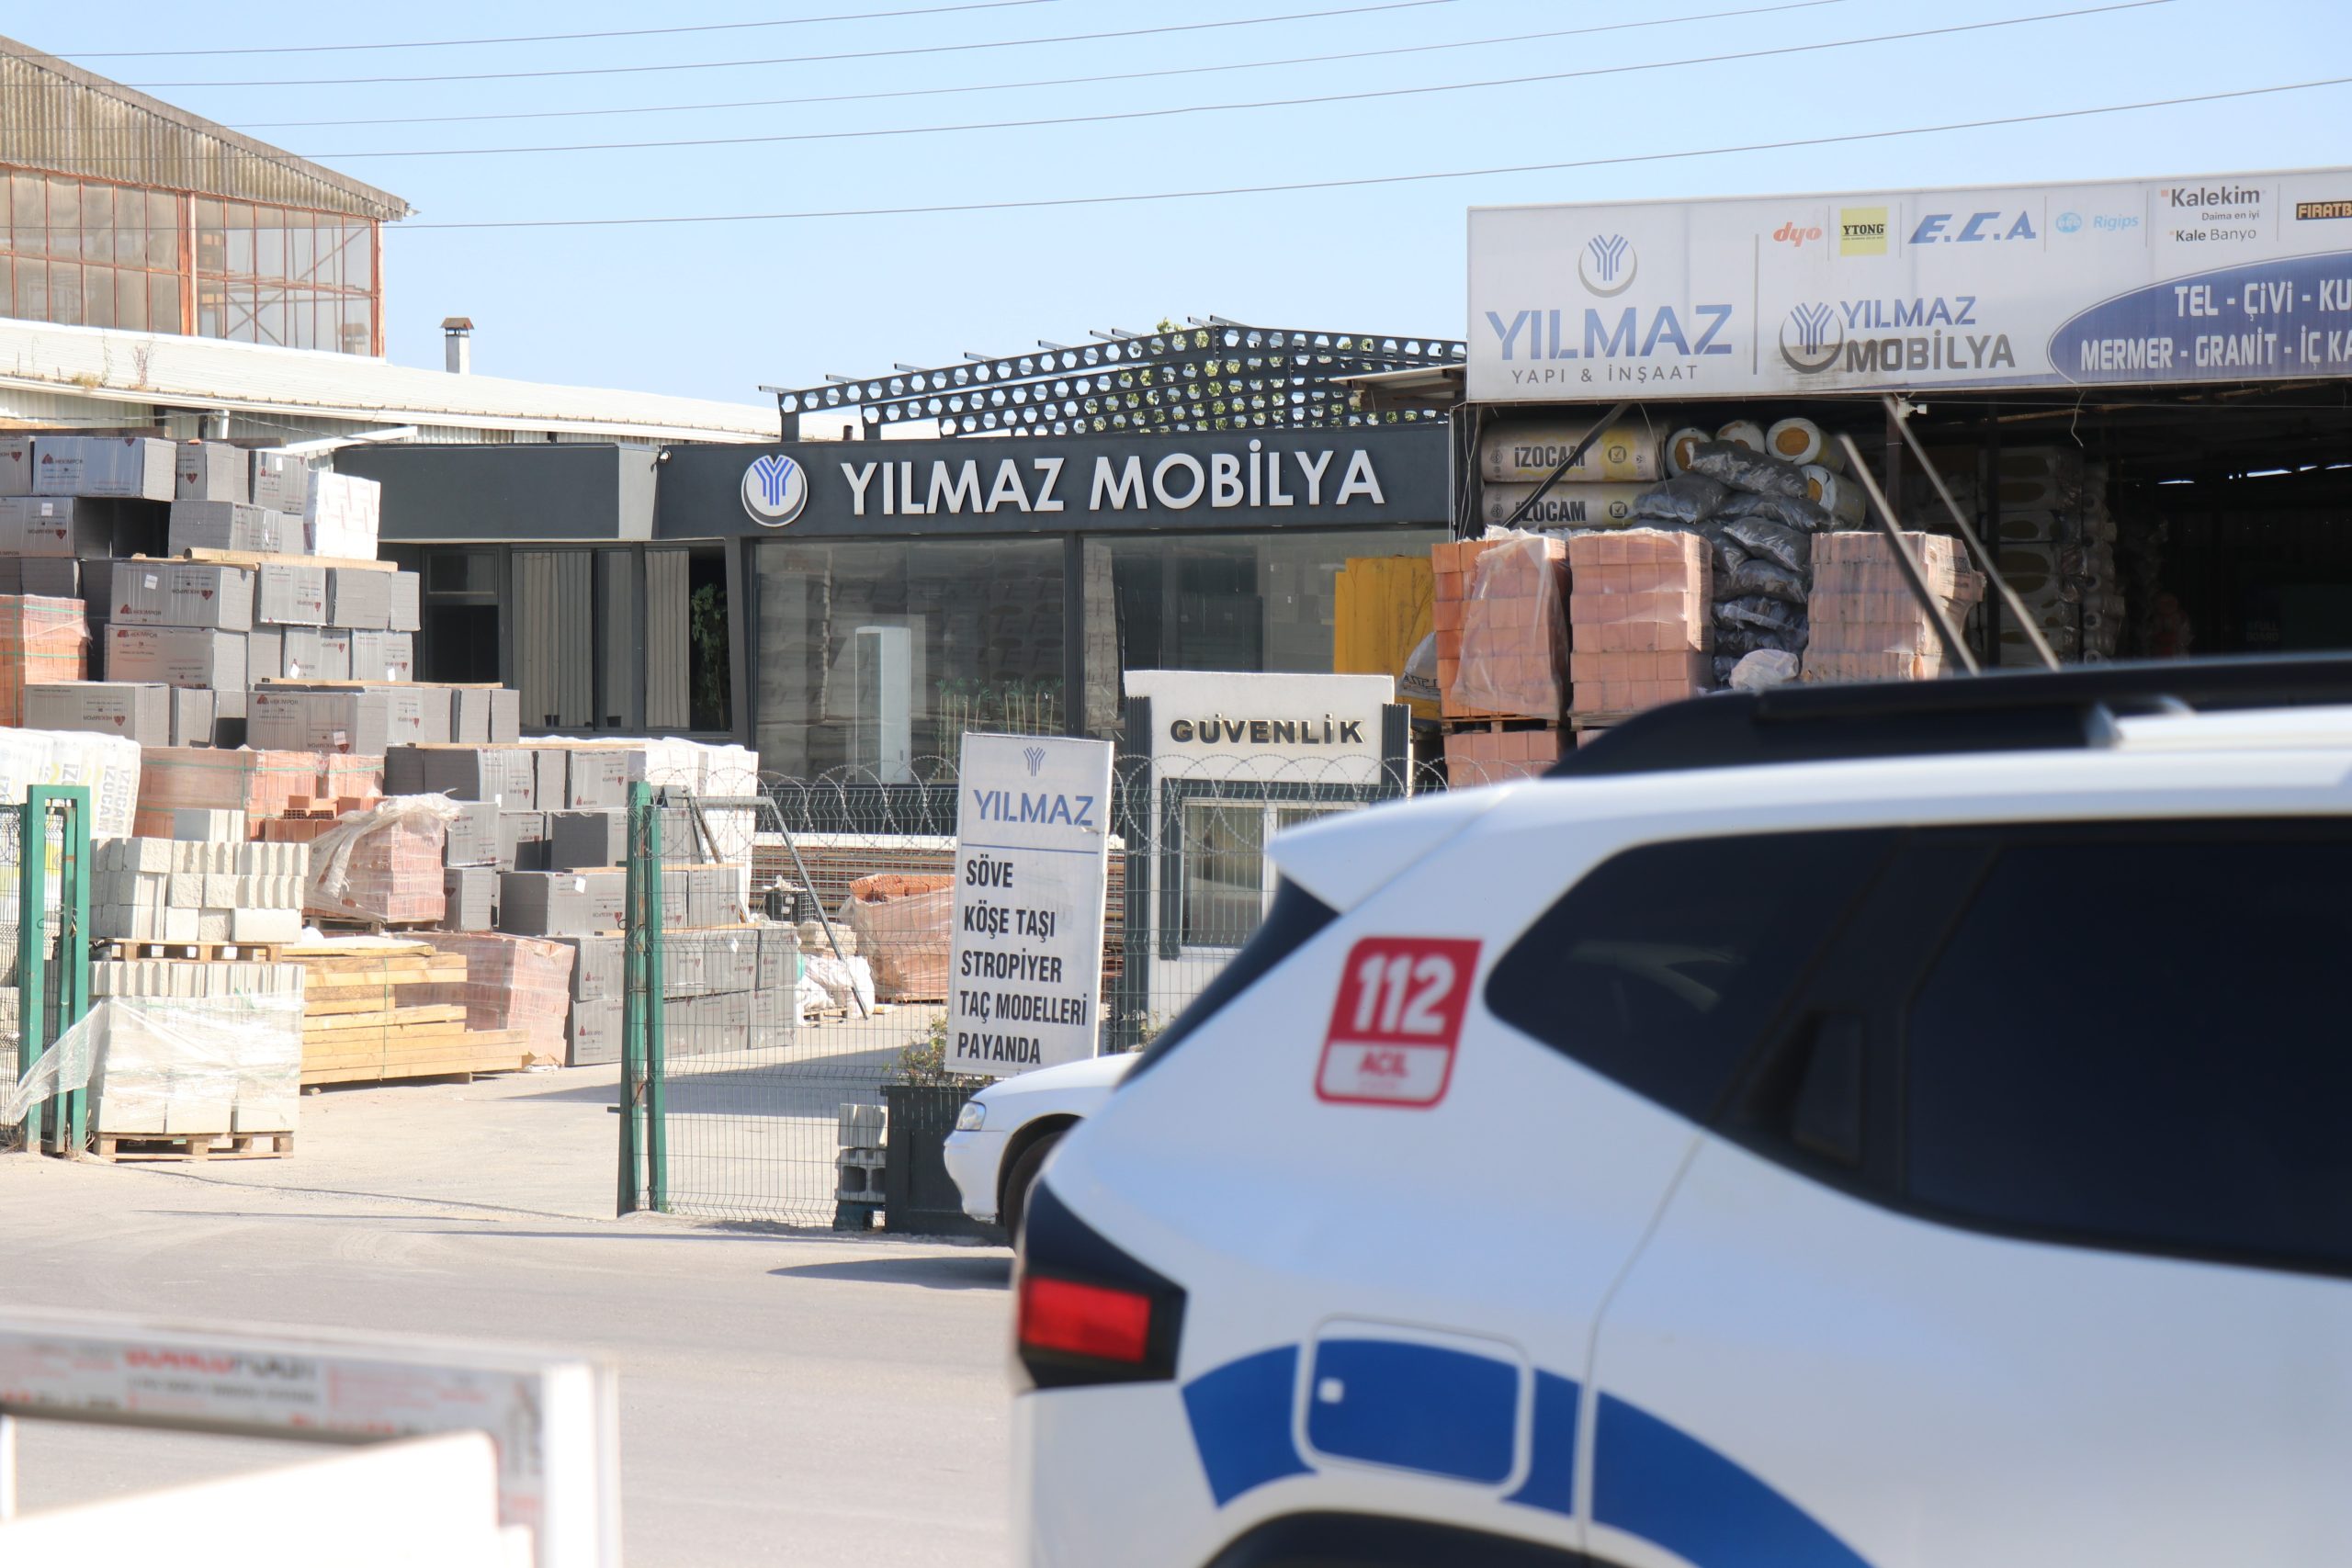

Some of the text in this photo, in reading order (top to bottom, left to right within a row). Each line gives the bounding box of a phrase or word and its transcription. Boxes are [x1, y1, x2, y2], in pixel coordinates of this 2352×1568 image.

[2171, 186, 2260, 208] Kalekim
[1843, 223, 1885, 235] YTONG
[2093, 213, 2139, 231] Rigips
[2201, 212, 2232, 221] Daima
[2248, 210, 2260, 220] iyi
[1773, 221, 1823, 247] dyo
[2176, 229, 2256, 243] Kale Banyo
[1840, 296, 1976, 329] YILMAZ
[2175, 285, 2219, 317] TEL
[1485, 304, 1733, 361] YILMAZ
[2081, 337, 2173, 371] MERMER
[2195, 327, 2278, 367] GRANİT
[2301, 324, 2322, 370] İÇ
[1846, 329, 2016, 373] MOBİLYA
[1511, 364, 1698, 385] YAPI & İNŞAAT
[841, 438, 1385, 515] YILMAZ MOBİLYA
[1170, 713, 1365, 744] GÜVENLİK
[973, 789, 1094, 826] YILMAZ
[966, 854, 1013, 888] SÖVE
[964, 900, 1056, 943] KÖŞE TAŞI
[961, 947, 1062, 984] STROPİYER
[960, 990, 1088, 1027] TAÇ MODELLERİ
[1352, 953, 1456, 1036] 112
[957, 1032, 1041, 1065] PAYANDA
